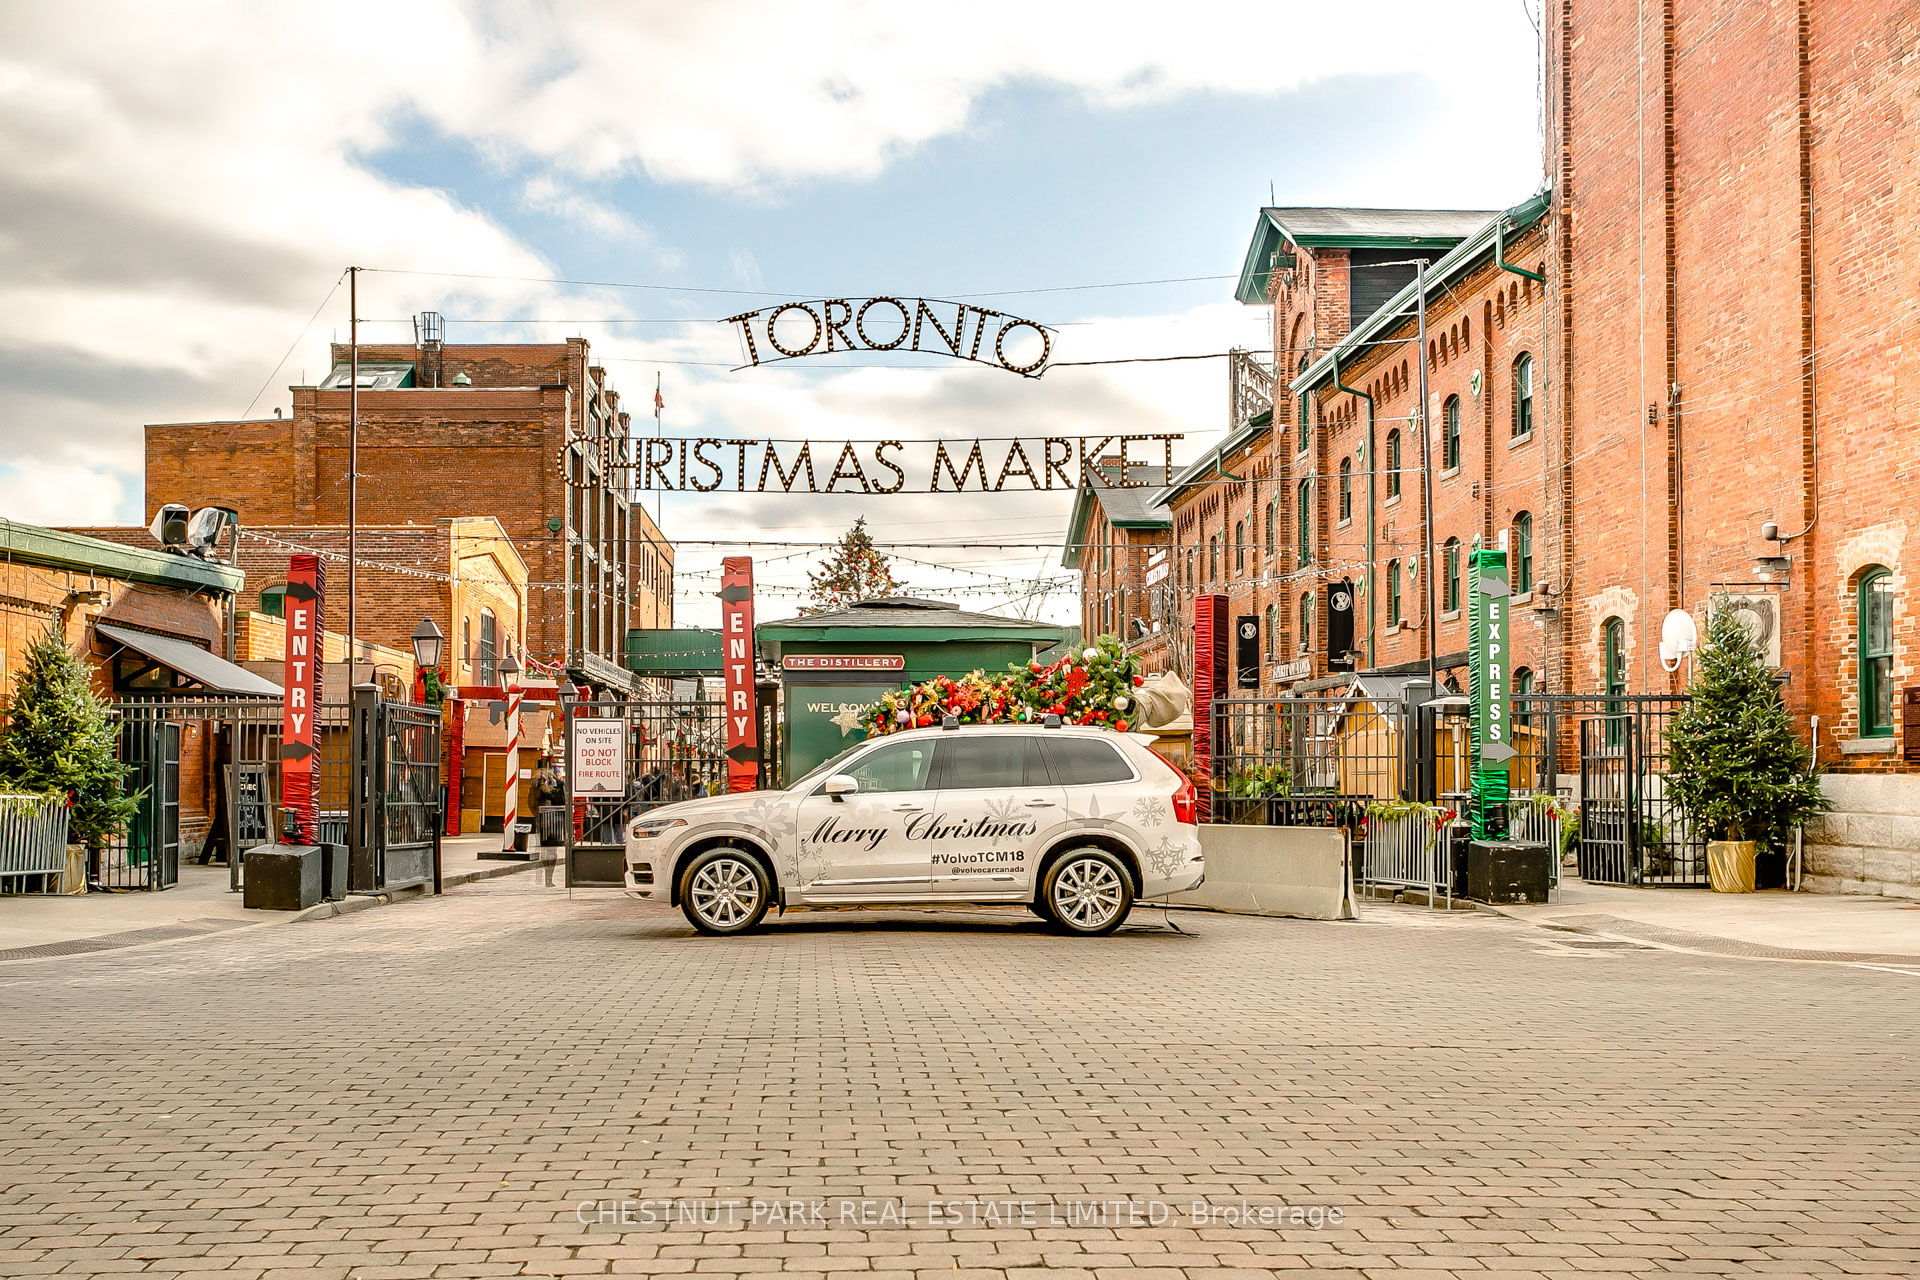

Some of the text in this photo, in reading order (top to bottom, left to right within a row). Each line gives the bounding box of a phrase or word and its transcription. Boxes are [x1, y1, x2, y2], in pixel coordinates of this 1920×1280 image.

[729, 296, 1050, 374] TORONTO
[556, 434, 1184, 493] CHRISTMAS MARKET
[291, 609, 308, 734] ENTRY
[730, 612, 750, 737] ENTRY
[789, 658, 814, 666] THE
[820, 658, 898, 666] DISTILLERY
[1488, 603, 1501, 740] EXPRESS
[807, 702, 876, 713] WELCOM
[581, 749, 617, 757] DO NOT
[585, 758, 612, 766] BLOCK
[801, 812, 1037, 851] Merry Christmas
[931, 850, 1025, 864] #VolvoTCM18
[952, 866, 1025, 875] @volvocarcanada
